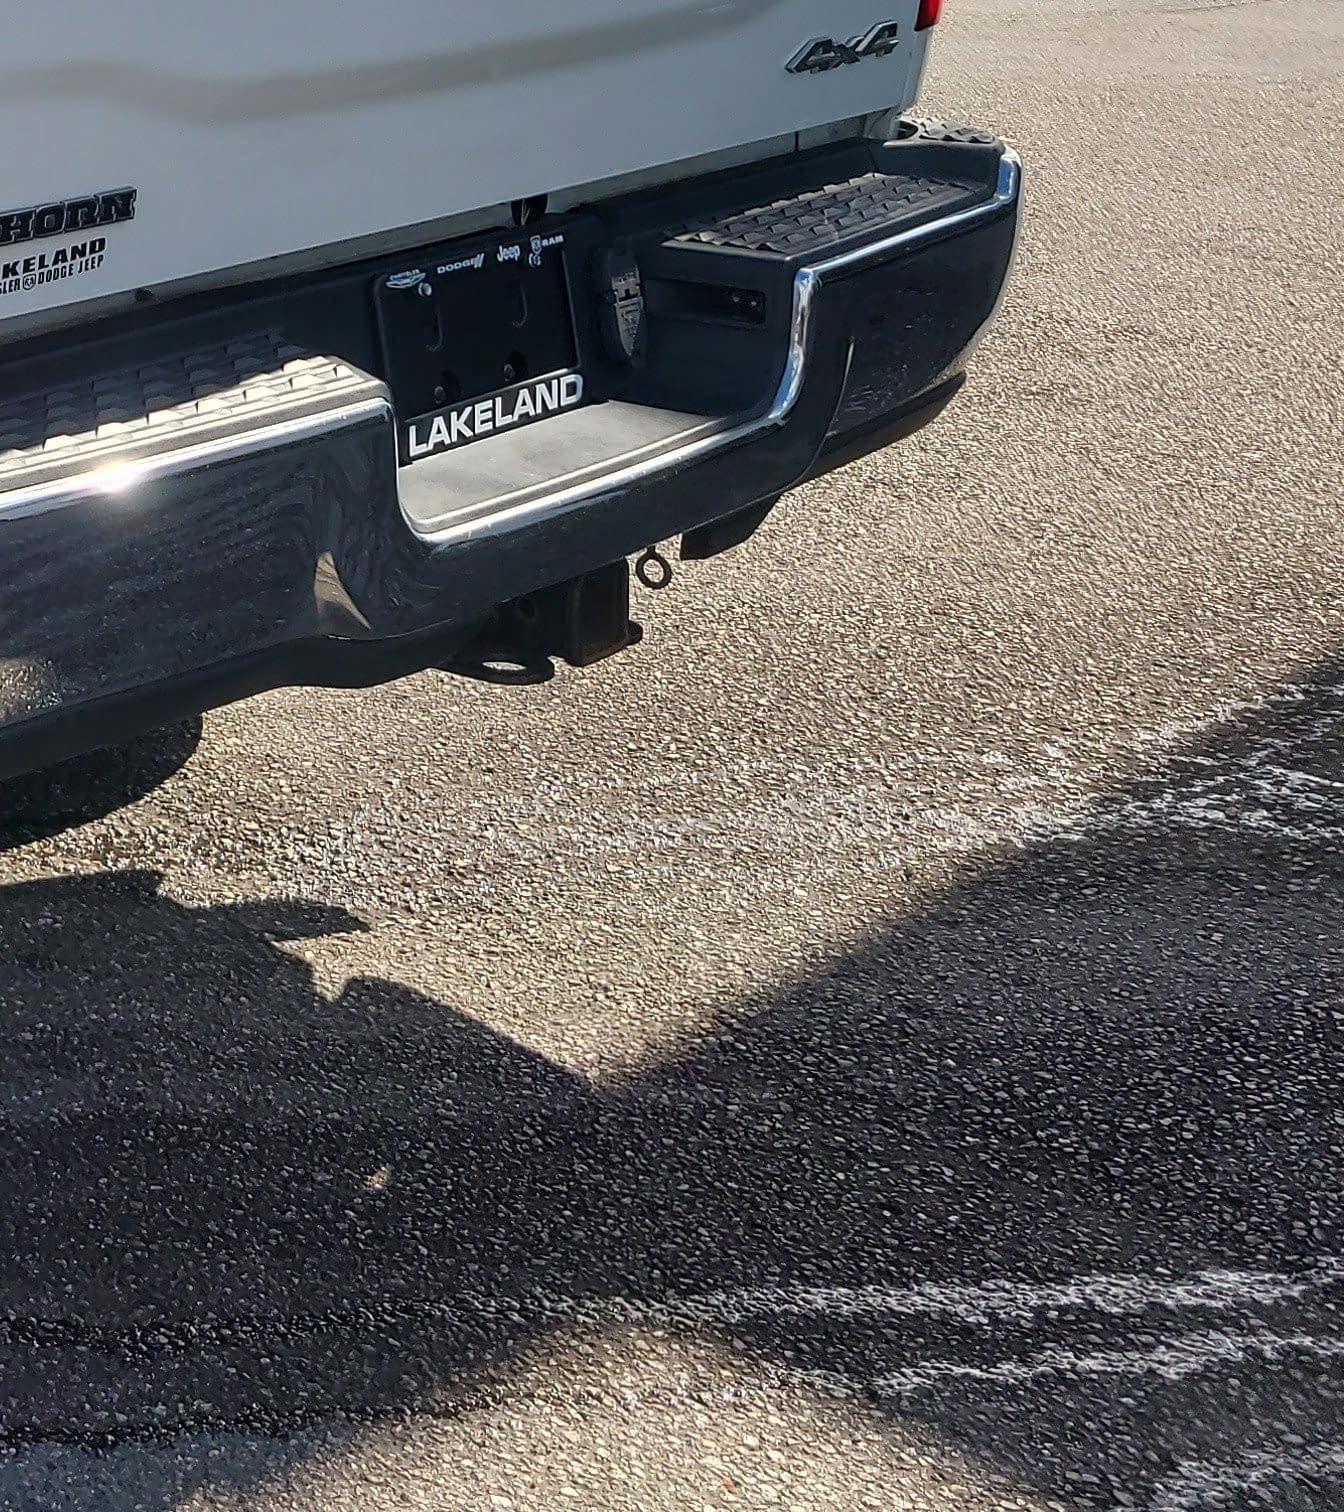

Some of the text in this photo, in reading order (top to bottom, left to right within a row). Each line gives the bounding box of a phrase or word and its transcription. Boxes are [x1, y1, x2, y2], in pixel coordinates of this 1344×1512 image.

[496, 245, 521, 263] Jeep
[542, 235, 564, 247] RAM
[37, 263, 75, 285] DODGE
[77, 254, 105, 275] JEEP
[409, 374, 583, 457] LAKELAND
